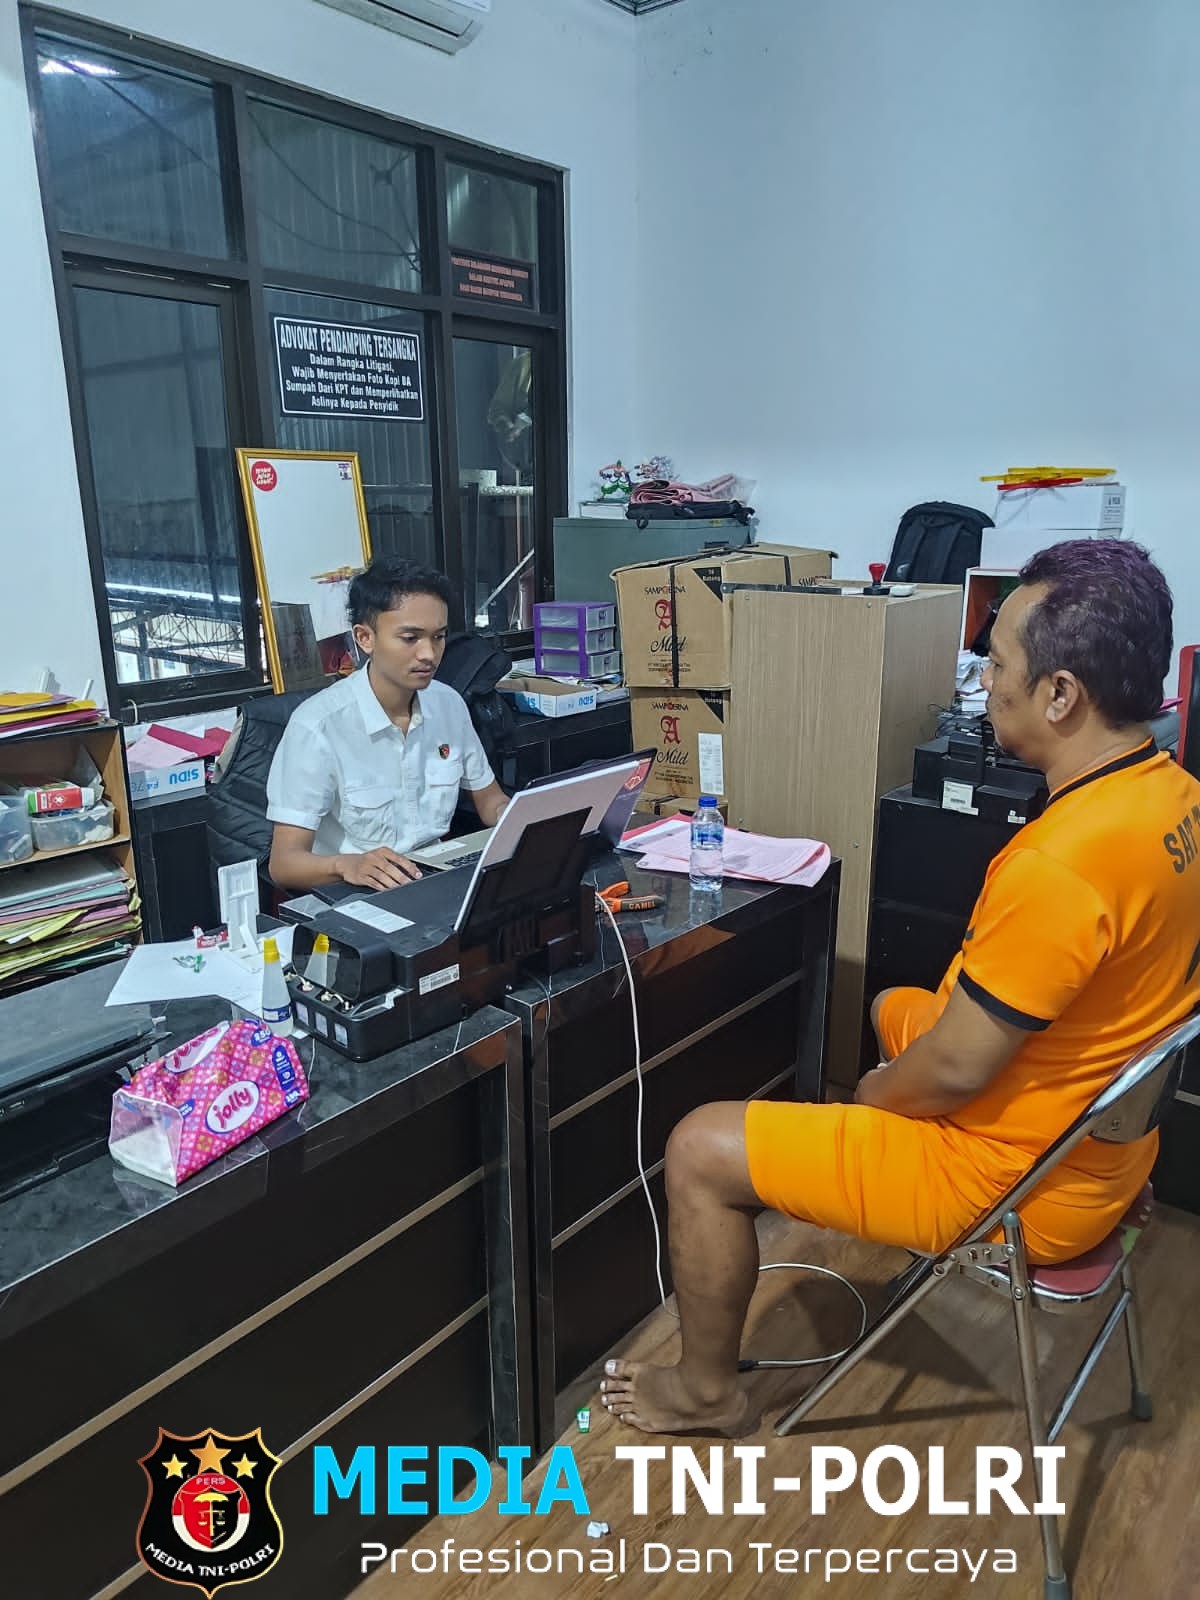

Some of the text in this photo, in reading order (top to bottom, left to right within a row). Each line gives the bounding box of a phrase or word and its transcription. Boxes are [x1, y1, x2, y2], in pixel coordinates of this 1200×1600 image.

[280, 324, 416, 361] ADVOKAT PENDAMPING TERSANGKA
[310, 353, 395, 373] Dalam Rangka Litigasi,
[292, 366, 315, 380] Wajib
[316, 369, 366, 383] Menyertakan
[367, 373, 384, 384] Foto
[385, 374, 401, 387] Kopi
[285, 380, 419, 400] Sumpah Dari KPT dan Memperlihatkan
[311, 396, 399, 413] Aslinya Kepada Penyidik
[656, 748, 689, 765] Mild
[1163, 815, 1199, 874] SAT
[214, 1087, 251, 1128] jolly
